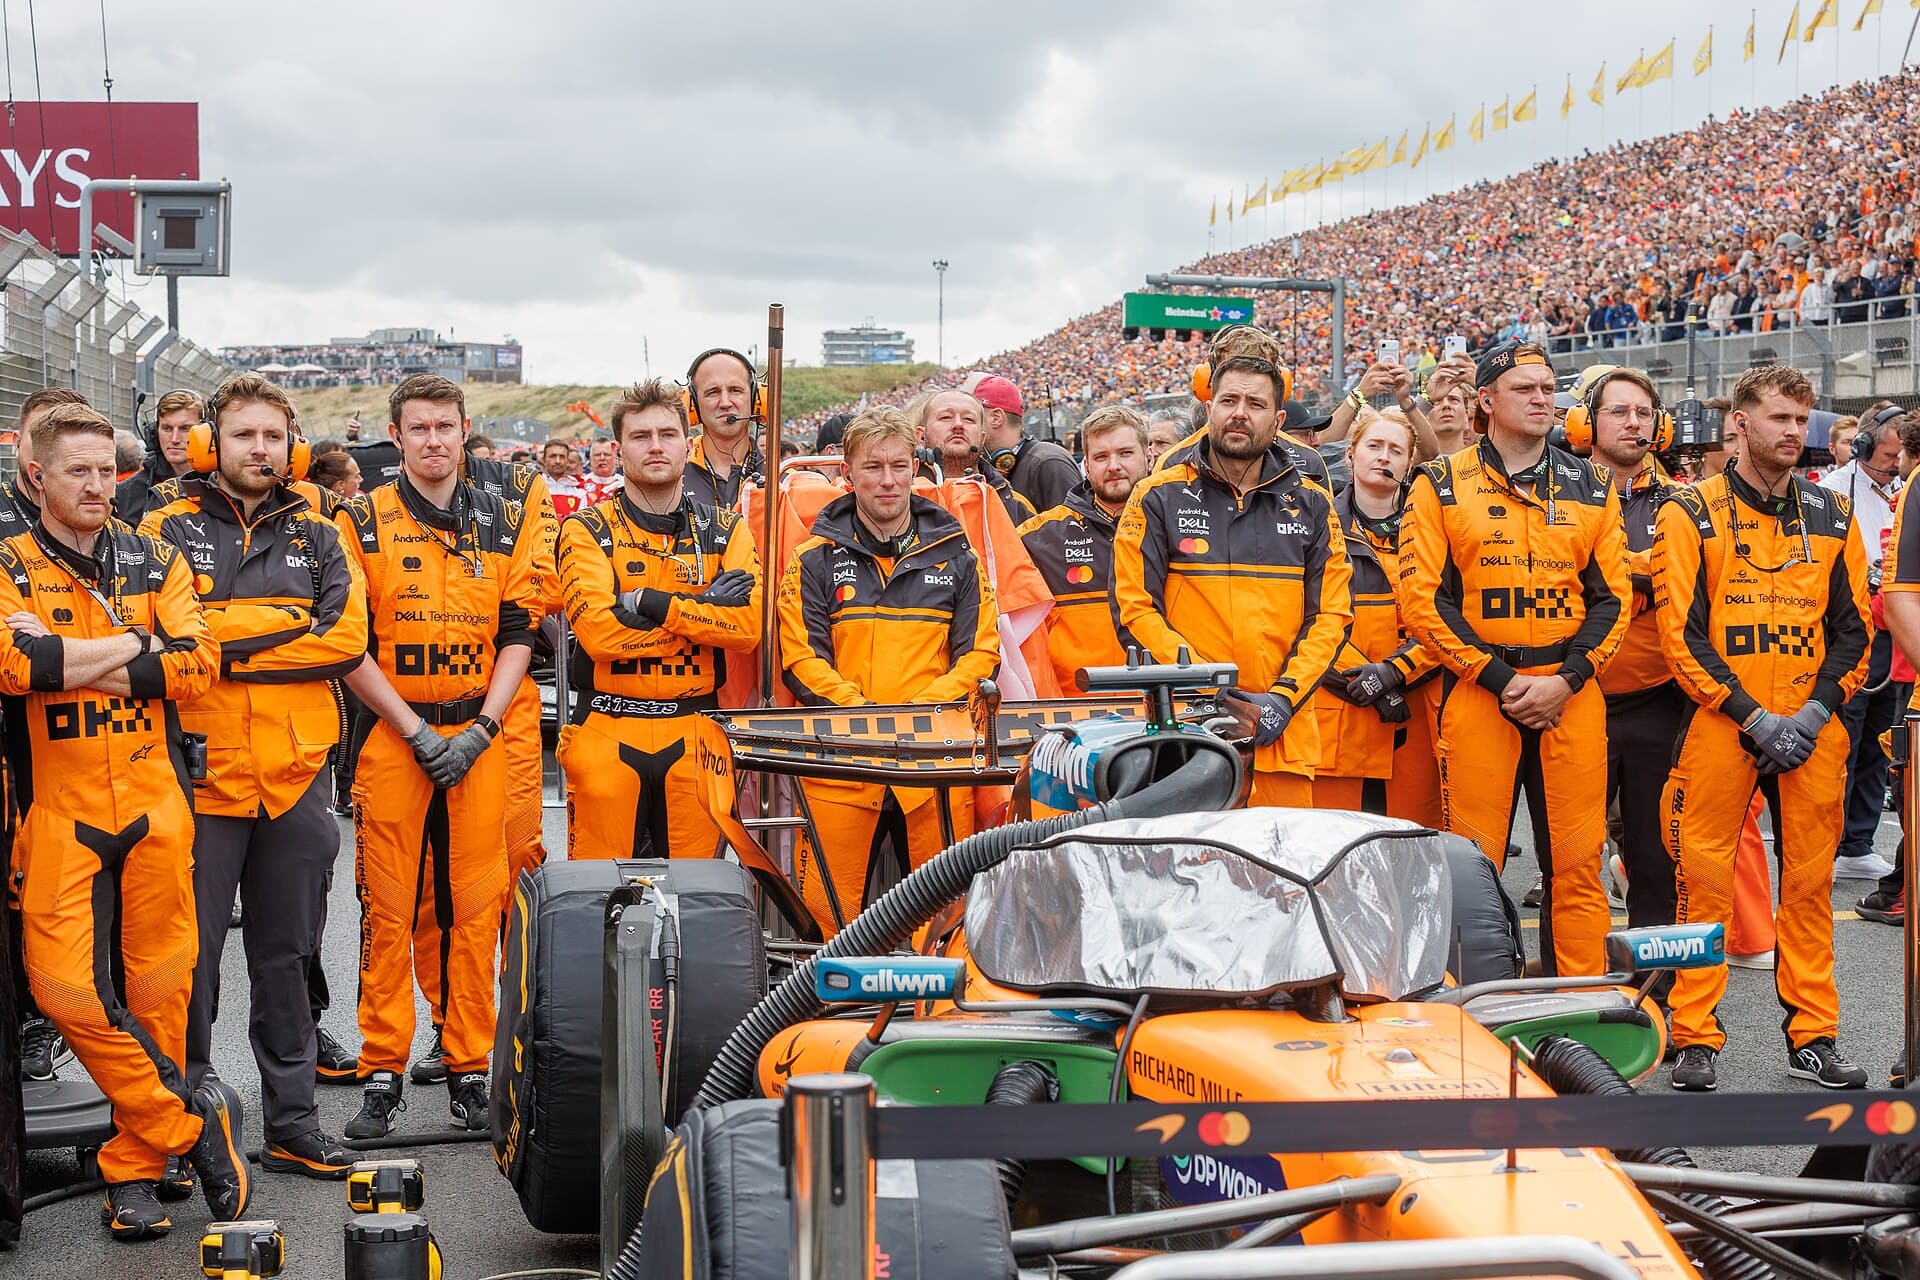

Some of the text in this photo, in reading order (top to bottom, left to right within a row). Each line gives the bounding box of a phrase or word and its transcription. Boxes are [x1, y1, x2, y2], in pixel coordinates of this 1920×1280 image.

[0, 148, 91, 208] YS
[1165, 306, 1207, 318] Heineken
[1178, 518, 1209, 529] DELL
[393, 533, 429, 543] Android
[1065, 548, 1094, 558] DELL
[1481, 555, 1575, 571] DELL Technologies
[37, 582, 74, 593] Android
[1481, 587, 1573, 620] OKX
[1725, 593, 1817, 608] DELL Technologies
[395, 610, 490, 626] DELL Technologies
[680, 611, 738, 632] RICHARD MILLE
[1426, 631, 1452, 657] RICHARD
[1725, 623, 1815, 657] OKX
[395, 643, 484, 676] OKX
[45, 698, 152, 741] OKX
[1638, 936, 1705, 961] allwyn
[860, 968, 946, 996] allwyn
[1133, 1051, 1195, 1098] RICHARD
[1371, 1081, 1484, 1093] Hilton
[1195, 1153, 1217, 1187] DP
